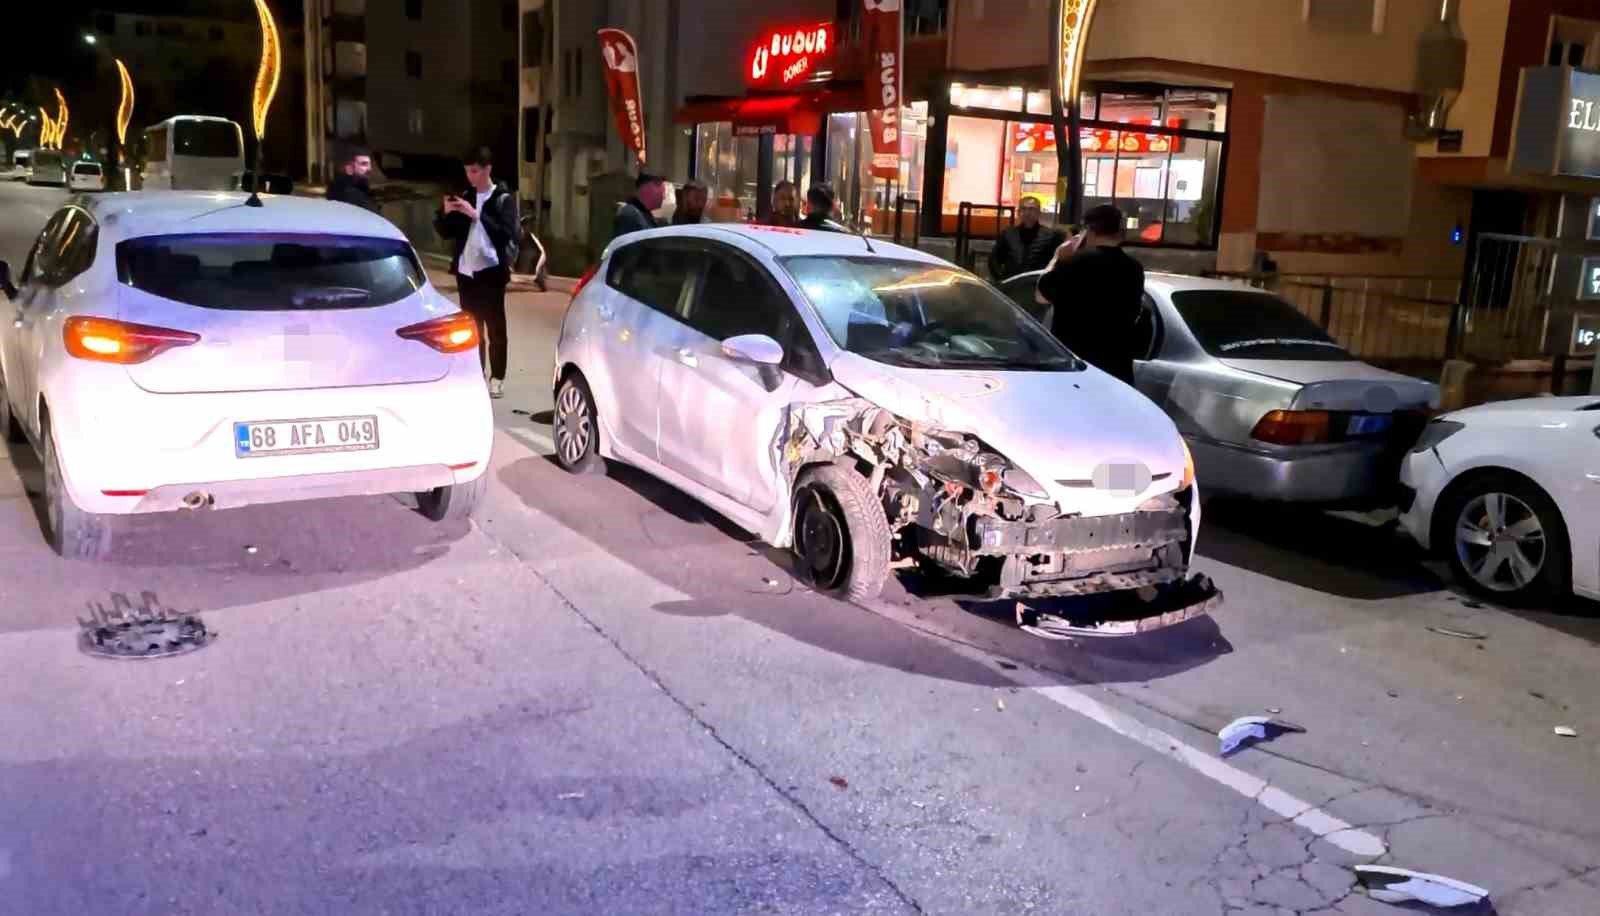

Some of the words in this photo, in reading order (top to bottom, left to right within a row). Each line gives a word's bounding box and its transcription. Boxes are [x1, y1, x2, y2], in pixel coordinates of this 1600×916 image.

[251, 426, 276, 448] 68
[290, 424, 326, 446] AFA
[338, 421, 373, 442] 049
